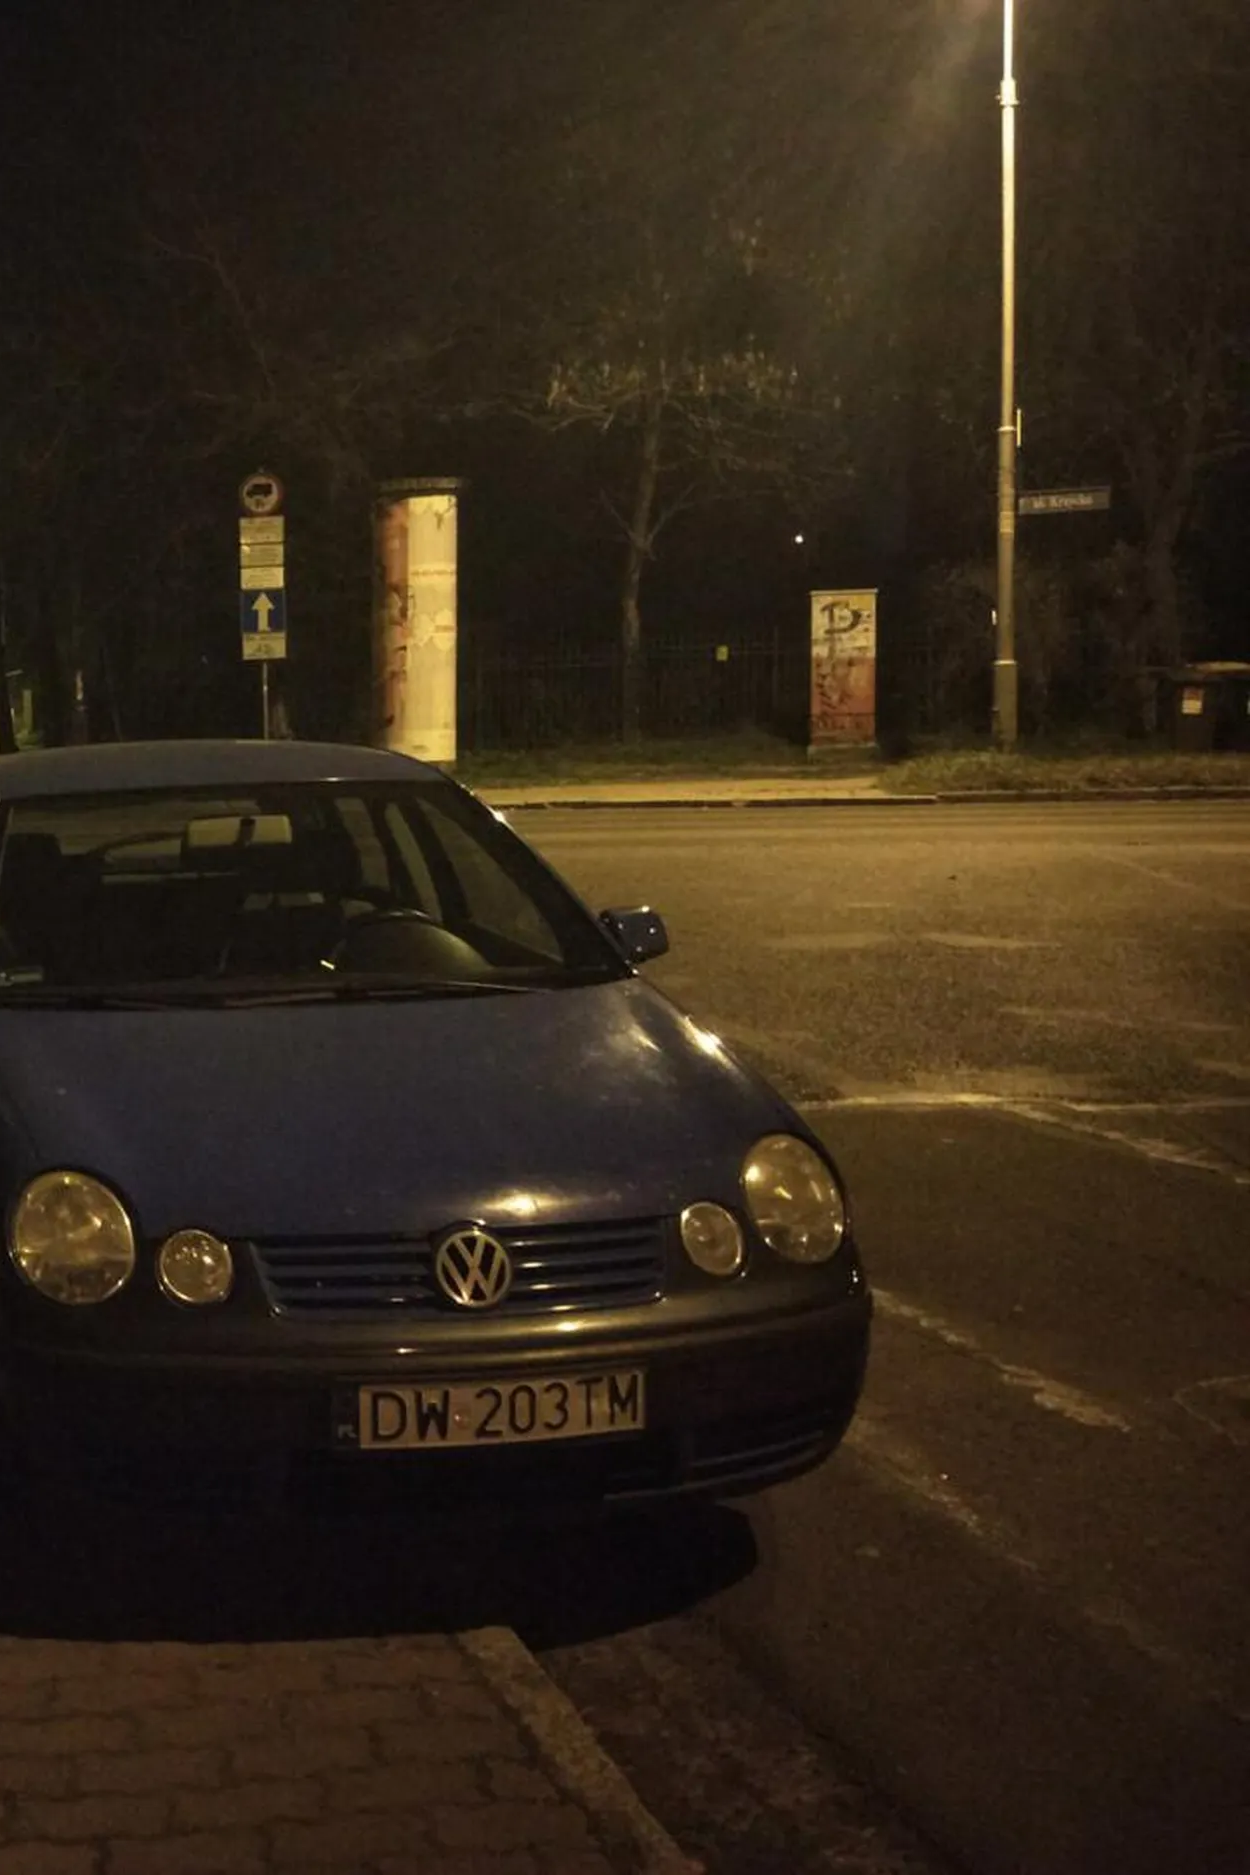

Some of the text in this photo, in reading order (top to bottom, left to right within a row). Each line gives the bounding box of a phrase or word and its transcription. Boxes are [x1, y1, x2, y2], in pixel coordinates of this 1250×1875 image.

[437, 1230, 511, 1307] VW
[372, 1374, 638, 1441] DW 203TM
